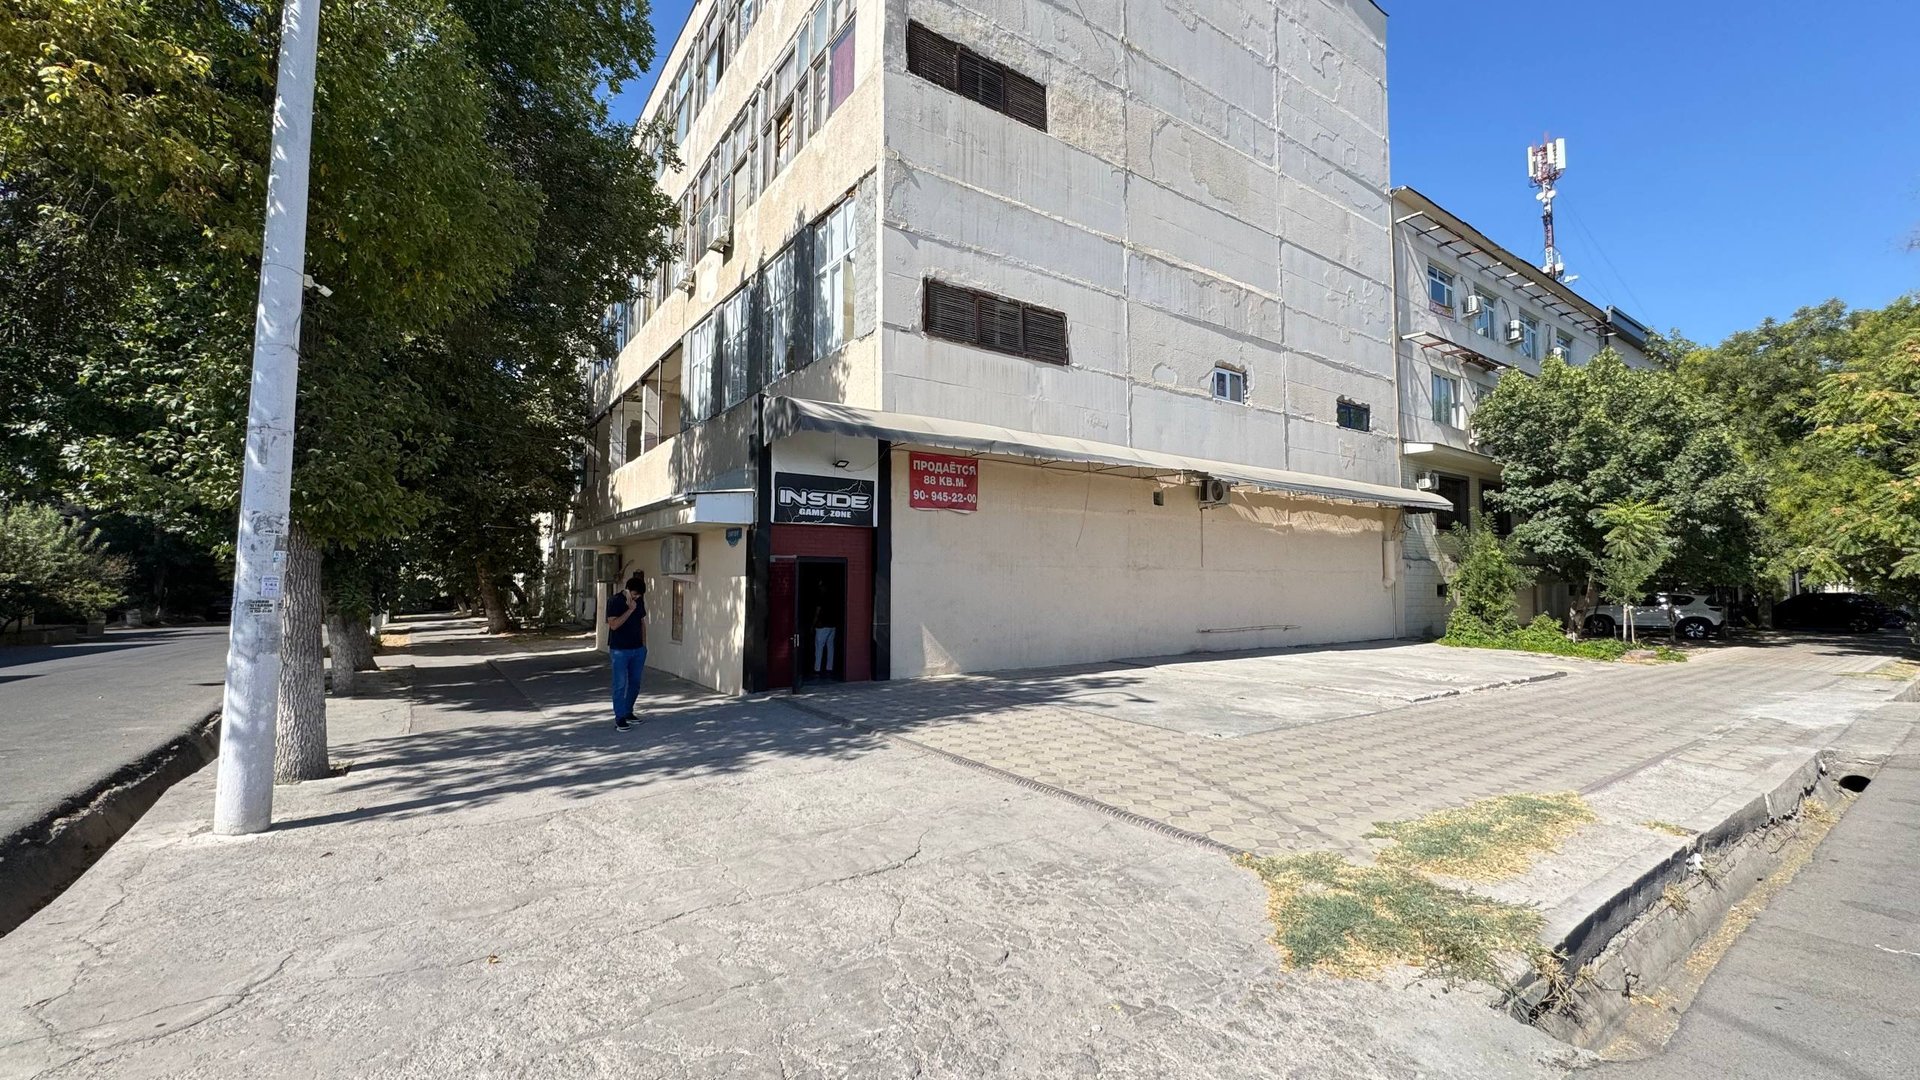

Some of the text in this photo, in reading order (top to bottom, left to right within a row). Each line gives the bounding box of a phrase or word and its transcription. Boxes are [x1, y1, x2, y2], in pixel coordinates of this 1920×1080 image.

[913, 460, 977, 475] ПРОДАЁТСЯ
[923, 475, 967, 488] 88 КВ.М.
[779, 489, 870, 509] INSIDE
[931, 491, 977, 504] 945-22-00
[799, 508, 852, 518] GAME ZONE
